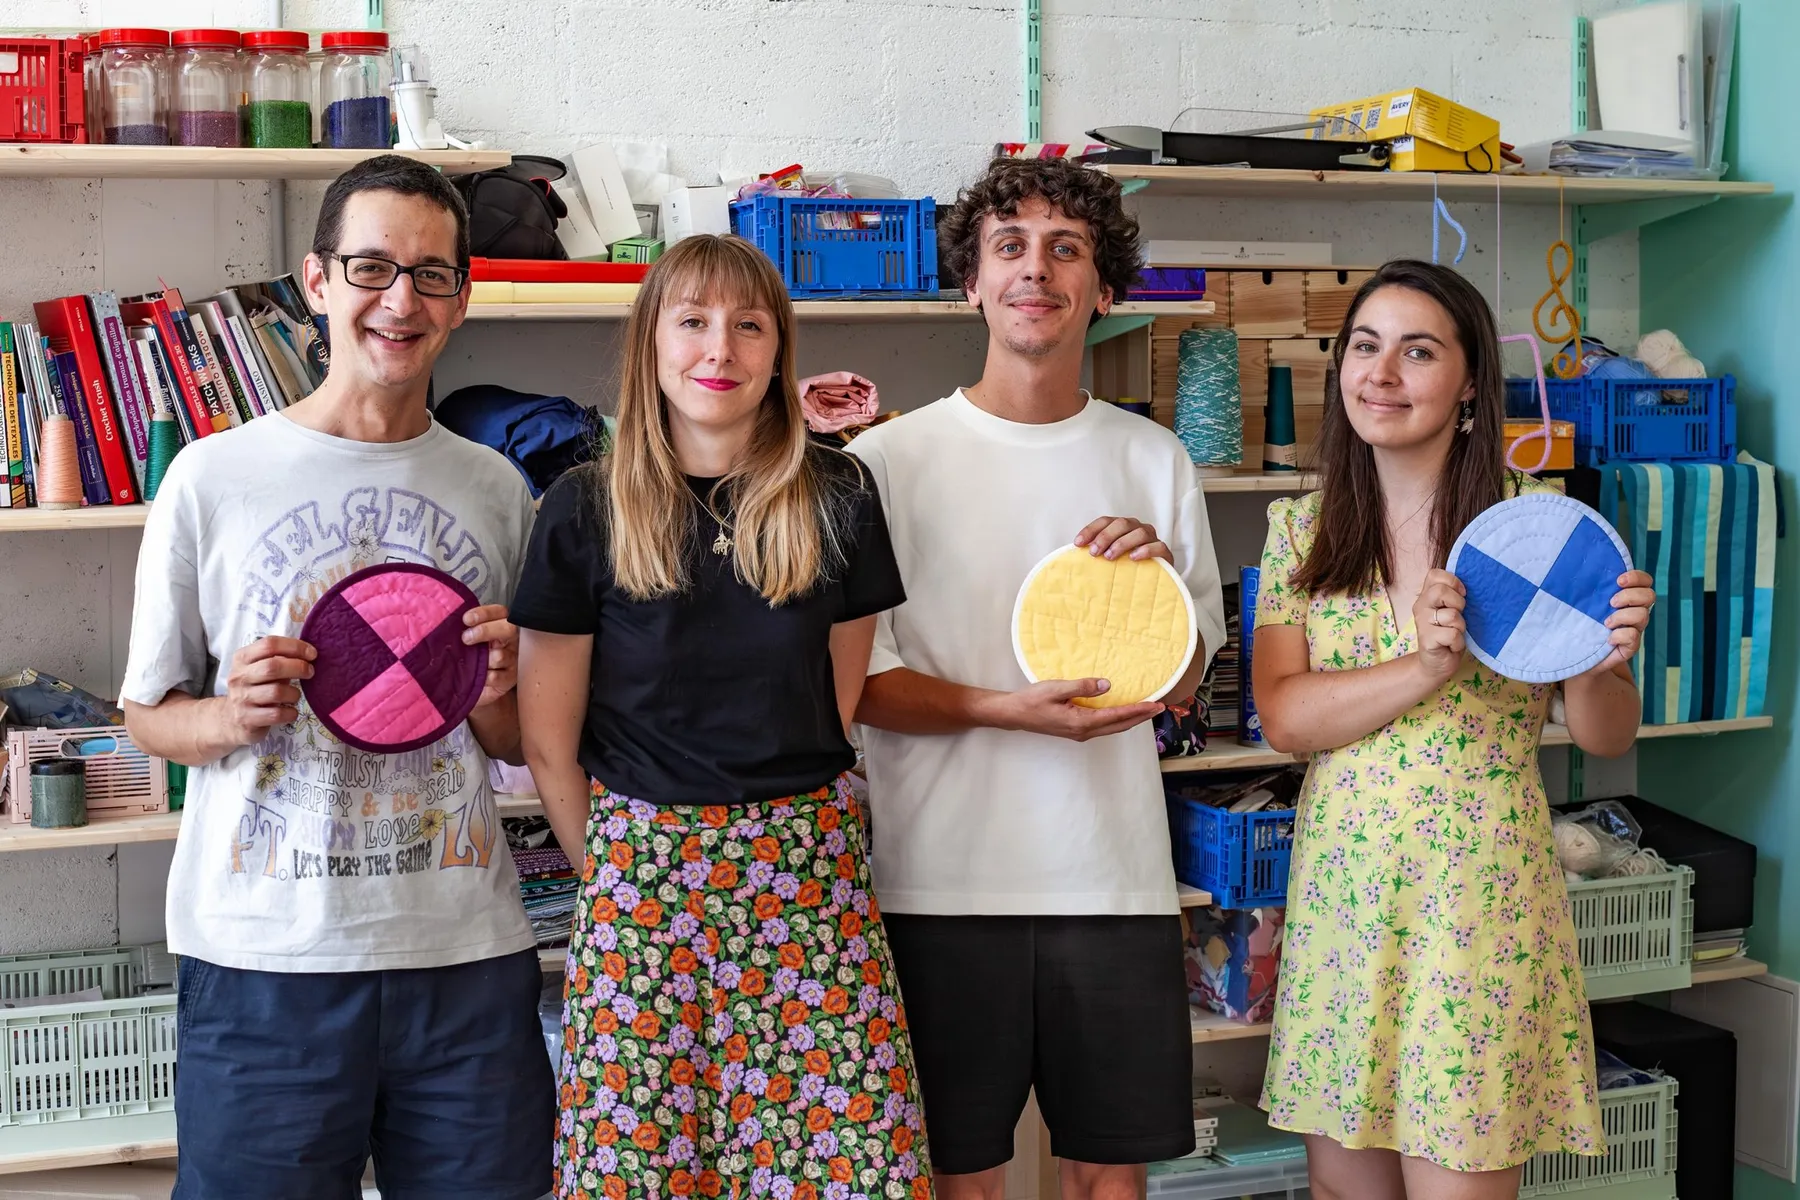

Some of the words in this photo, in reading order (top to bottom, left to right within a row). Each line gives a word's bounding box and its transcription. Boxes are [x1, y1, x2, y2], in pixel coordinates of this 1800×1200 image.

[1391, 100, 1410, 110] AVERY
[1393, 136, 1411, 145] AVERY
[302, 315, 323, 345] JAMES
[173, 345, 181, 355] DE
[177, 354, 189, 375] MODE
[196, 330, 217, 371] MODERN
[213, 372, 235, 418] QUILTING
[119, 361, 130, 390] travaux
[187, 344, 221, 417] PATCHWORKS
[252, 370, 270, 404] SASHIKO
[53, 384, 62, 398] 250
[92, 379, 105, 406] Crush
[125, 390, 134, 403] des
[5, 354, 15, 407] TECHNOLOGIE
[11, 424, 19, 459] TEXTILES
[100, 406, 114, 442] Crochet
[128, 404, 147, 455] L'encyclopédie
[361, 791, 380, 817] &
